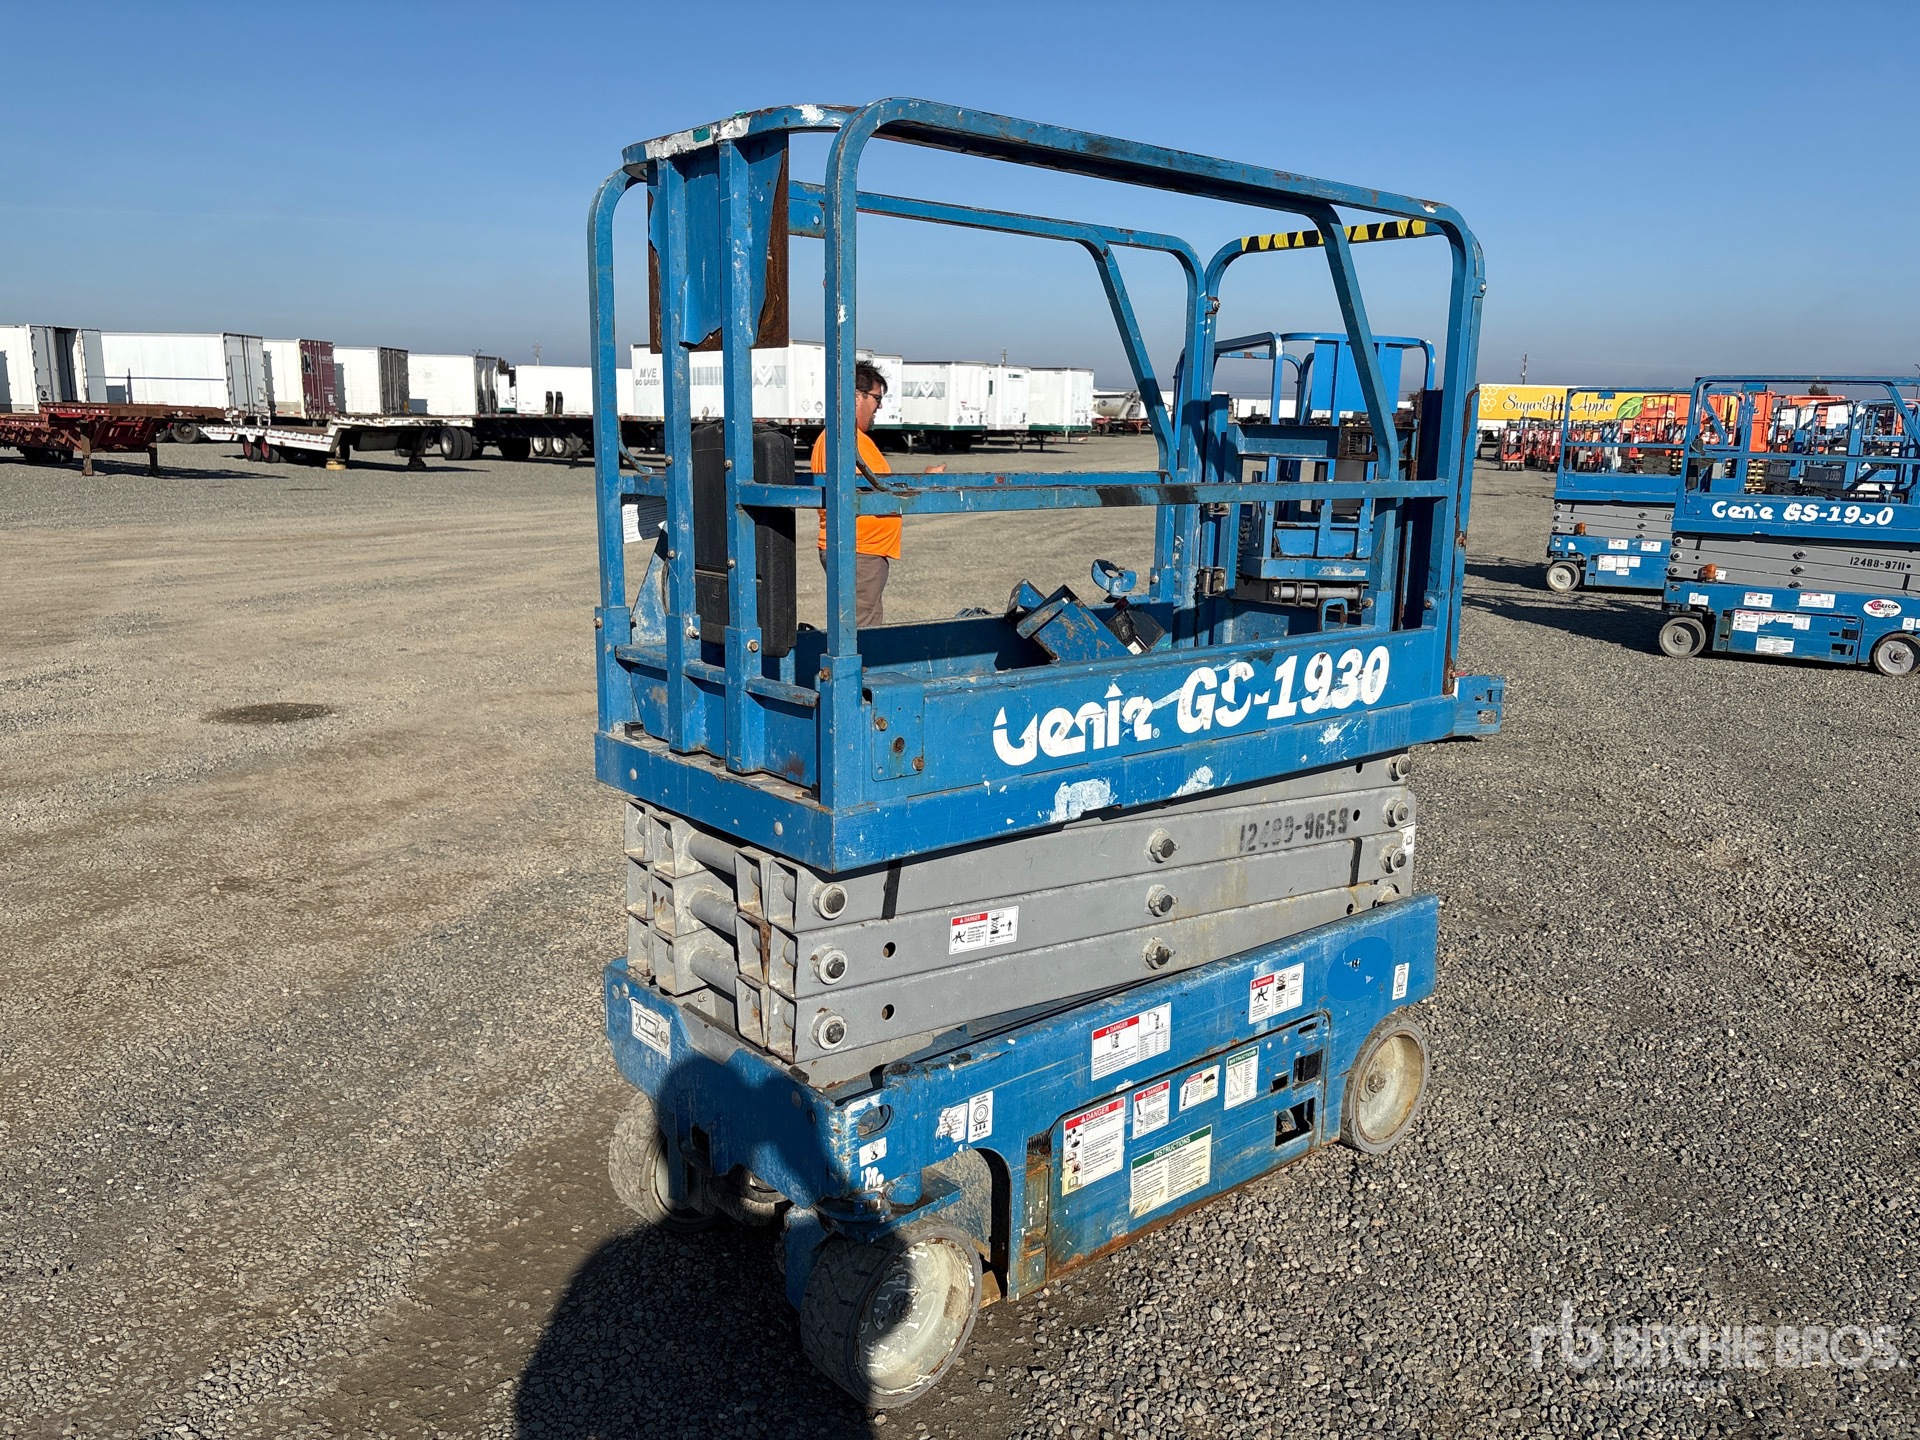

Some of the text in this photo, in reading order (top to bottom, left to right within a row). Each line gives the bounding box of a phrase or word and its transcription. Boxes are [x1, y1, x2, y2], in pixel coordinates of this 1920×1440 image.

[640, 368, 657, 378] MVE
[1570, 394, 1613, 417] Apple
[1783, 502, 1894, 526] GS-1930
[1849, 556, 1905, 571] 12488-9711
[1176, 645, 1390, 734] GS-1930
[1109, 1020, 1129, 1033] DANGER
[1229, 1050, 1257, 1065] INSTRUCTIONS
[1146, 1084, 1165, 1098] DANGER
[1085, 1105, 1110, 1121] DANGER
[1153, 1136, 1191, 1159] INSTRUCTIONS
